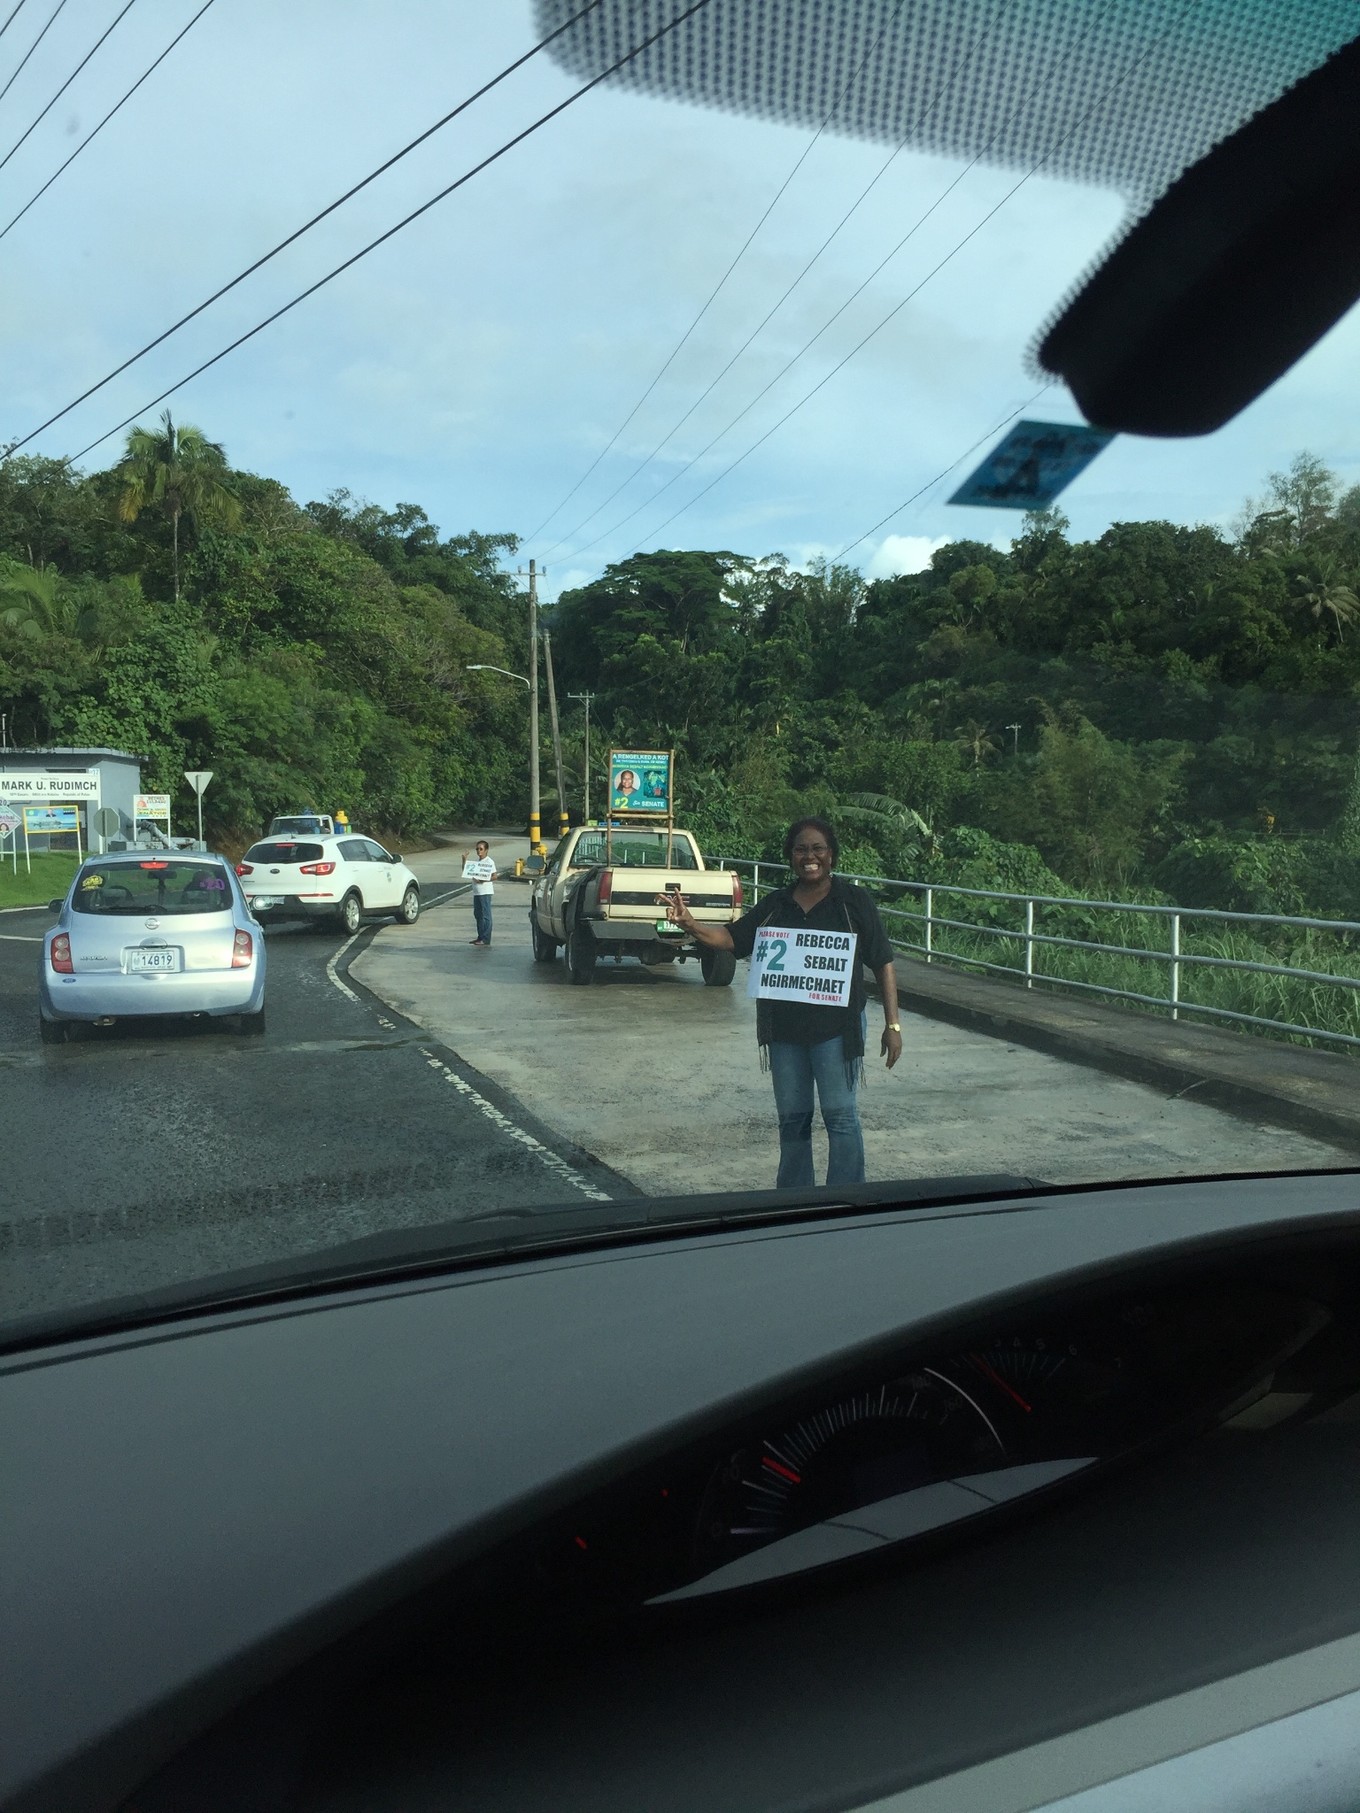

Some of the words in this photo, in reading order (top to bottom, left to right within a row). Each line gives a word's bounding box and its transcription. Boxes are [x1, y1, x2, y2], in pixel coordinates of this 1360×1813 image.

[1, 781, 33, 790] MARK
[36, 781, 46, 790] U.
[49, 781, 97, 790] RUDIMCH
[614, 796, 629, 809] #2
[776, 931, 790, 939] VOTE
[795, 933, 850, 951] REBECCA
[142, 954, 172, 966] 14819
[756, 939, 788, 972] #2
[803, 954, 848, 972] SEBALT
[760, 973, 846, 995] NGIRMECHAET
[808, 992, 820, 1000] FOR
[821, 994, 842, 1002] SENATE
